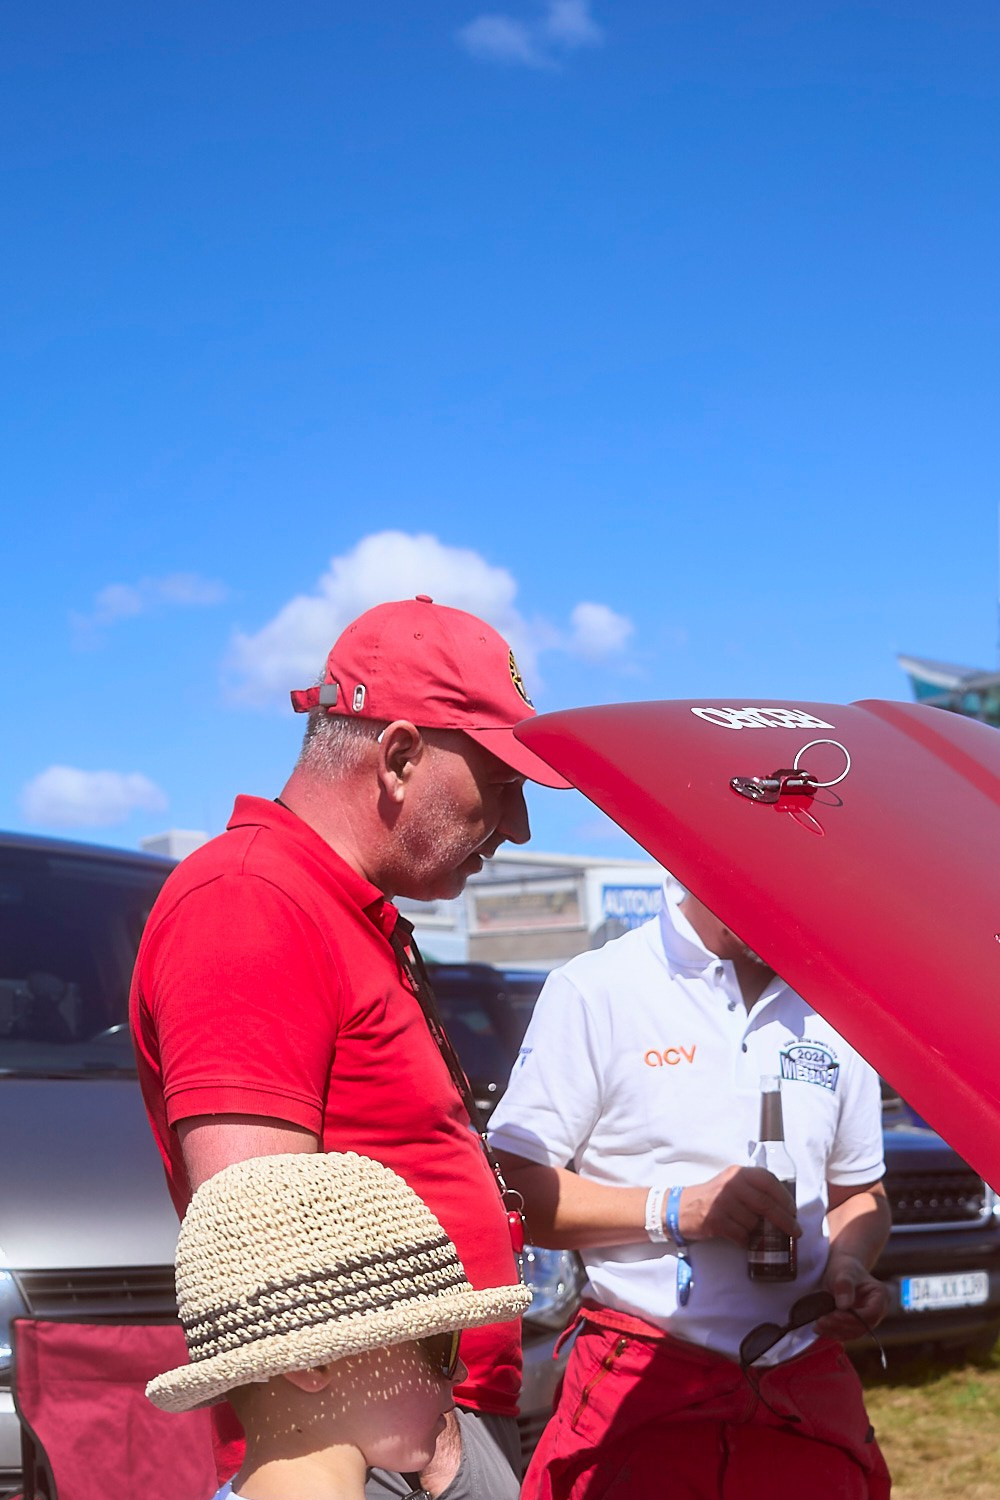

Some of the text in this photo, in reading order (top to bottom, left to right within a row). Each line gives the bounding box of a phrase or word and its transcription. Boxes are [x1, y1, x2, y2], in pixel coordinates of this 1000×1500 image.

[690, 706, 836, 730] RECARO
[644, 1043, 697, 1068] acv
[797, 1049, 826, 1064] 2024
